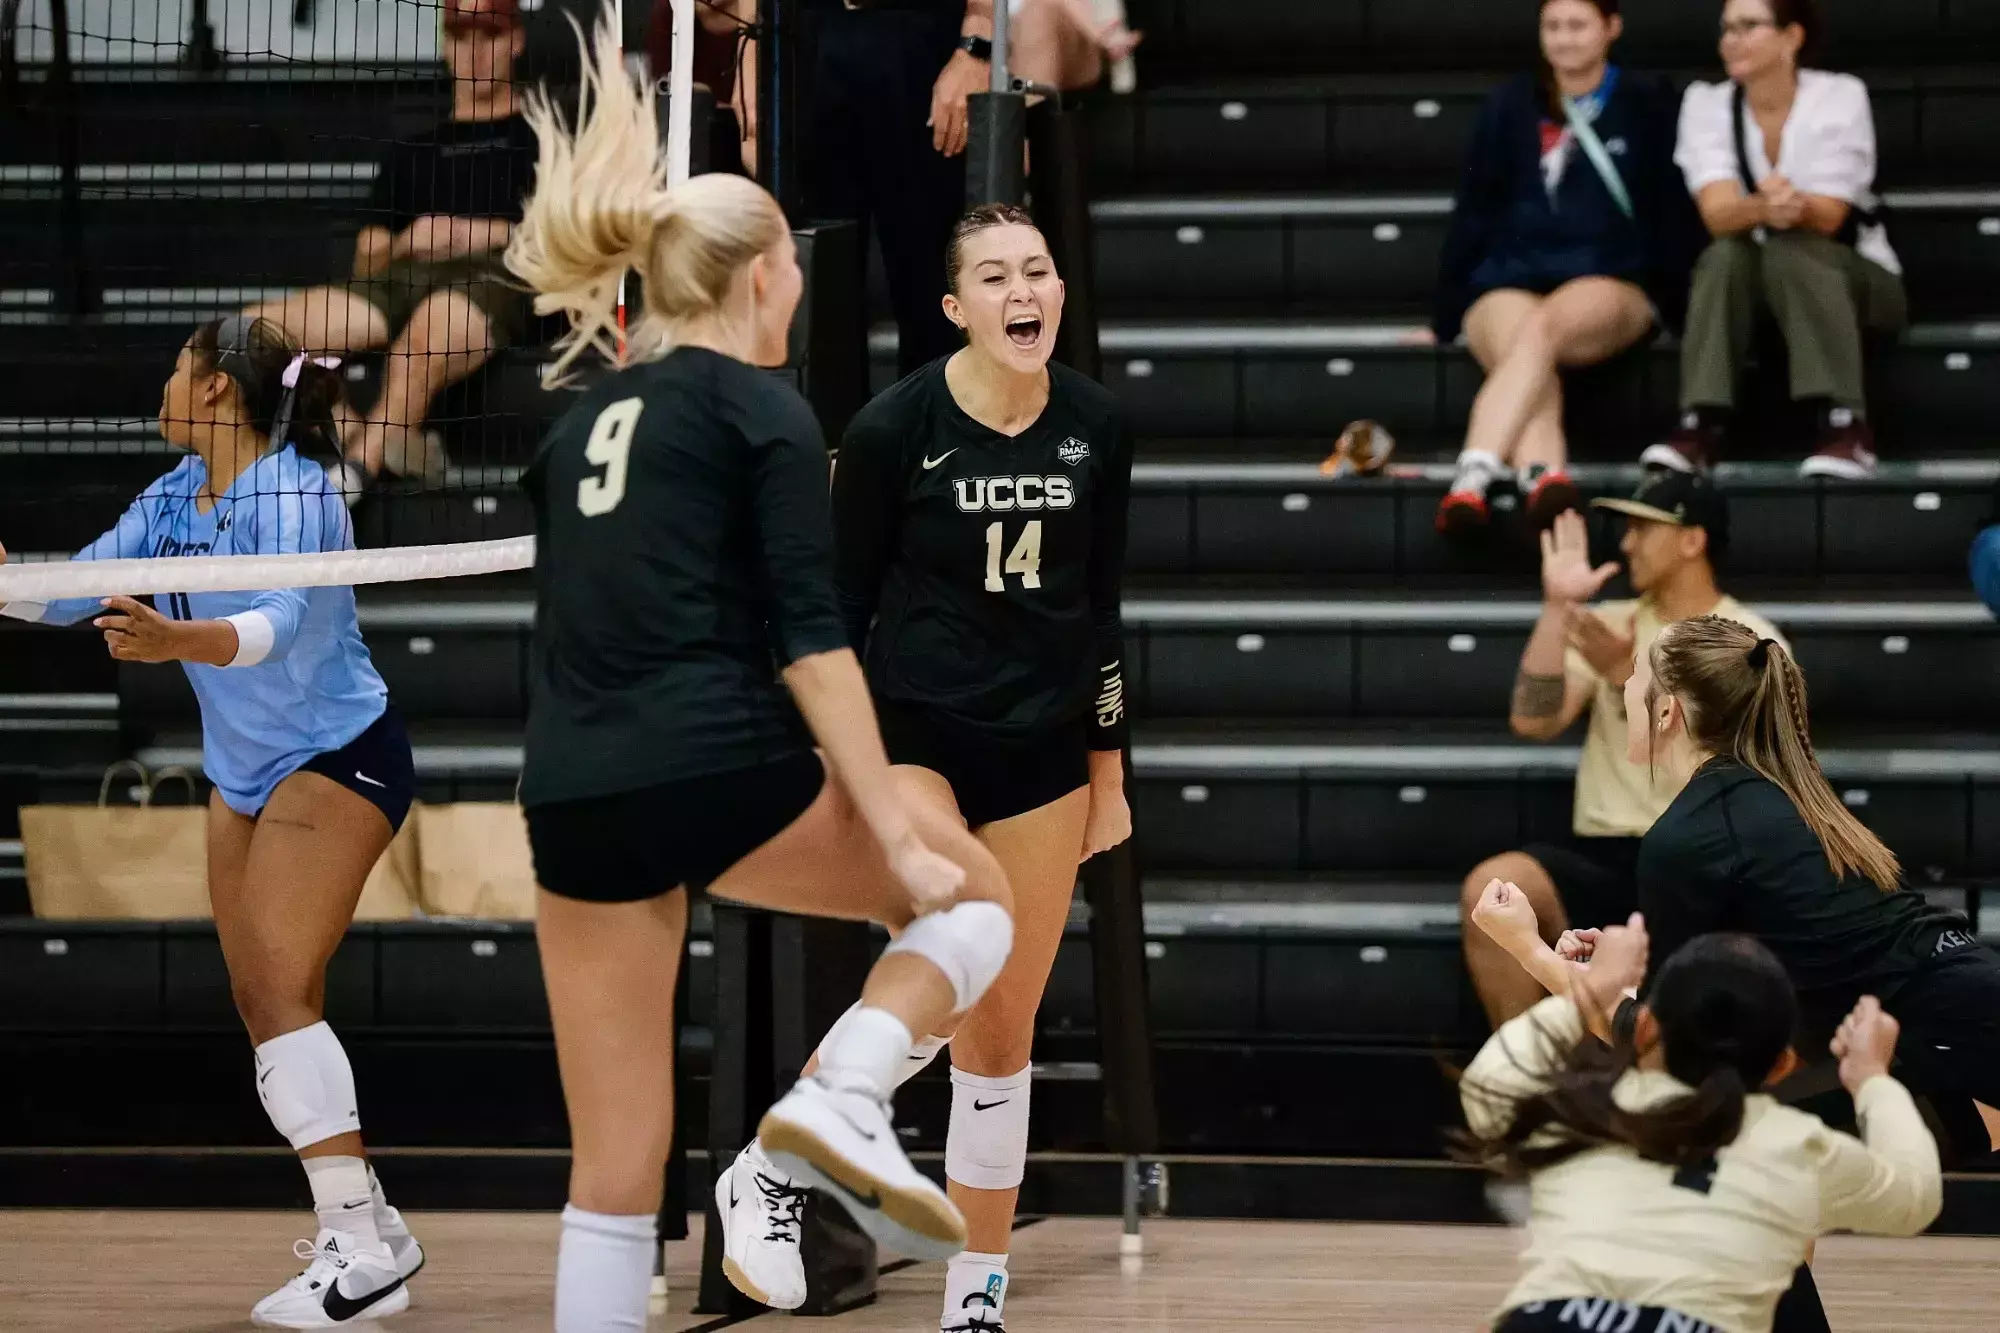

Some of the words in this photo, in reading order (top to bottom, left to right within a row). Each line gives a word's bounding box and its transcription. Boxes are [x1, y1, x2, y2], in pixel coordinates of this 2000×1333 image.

[577, 396, 644, 517] 9
[1059, 445, 1088, 457] RMAC
[953, 475, 1075, 512] UCCS
[984, 520, 1042, 592] 14
